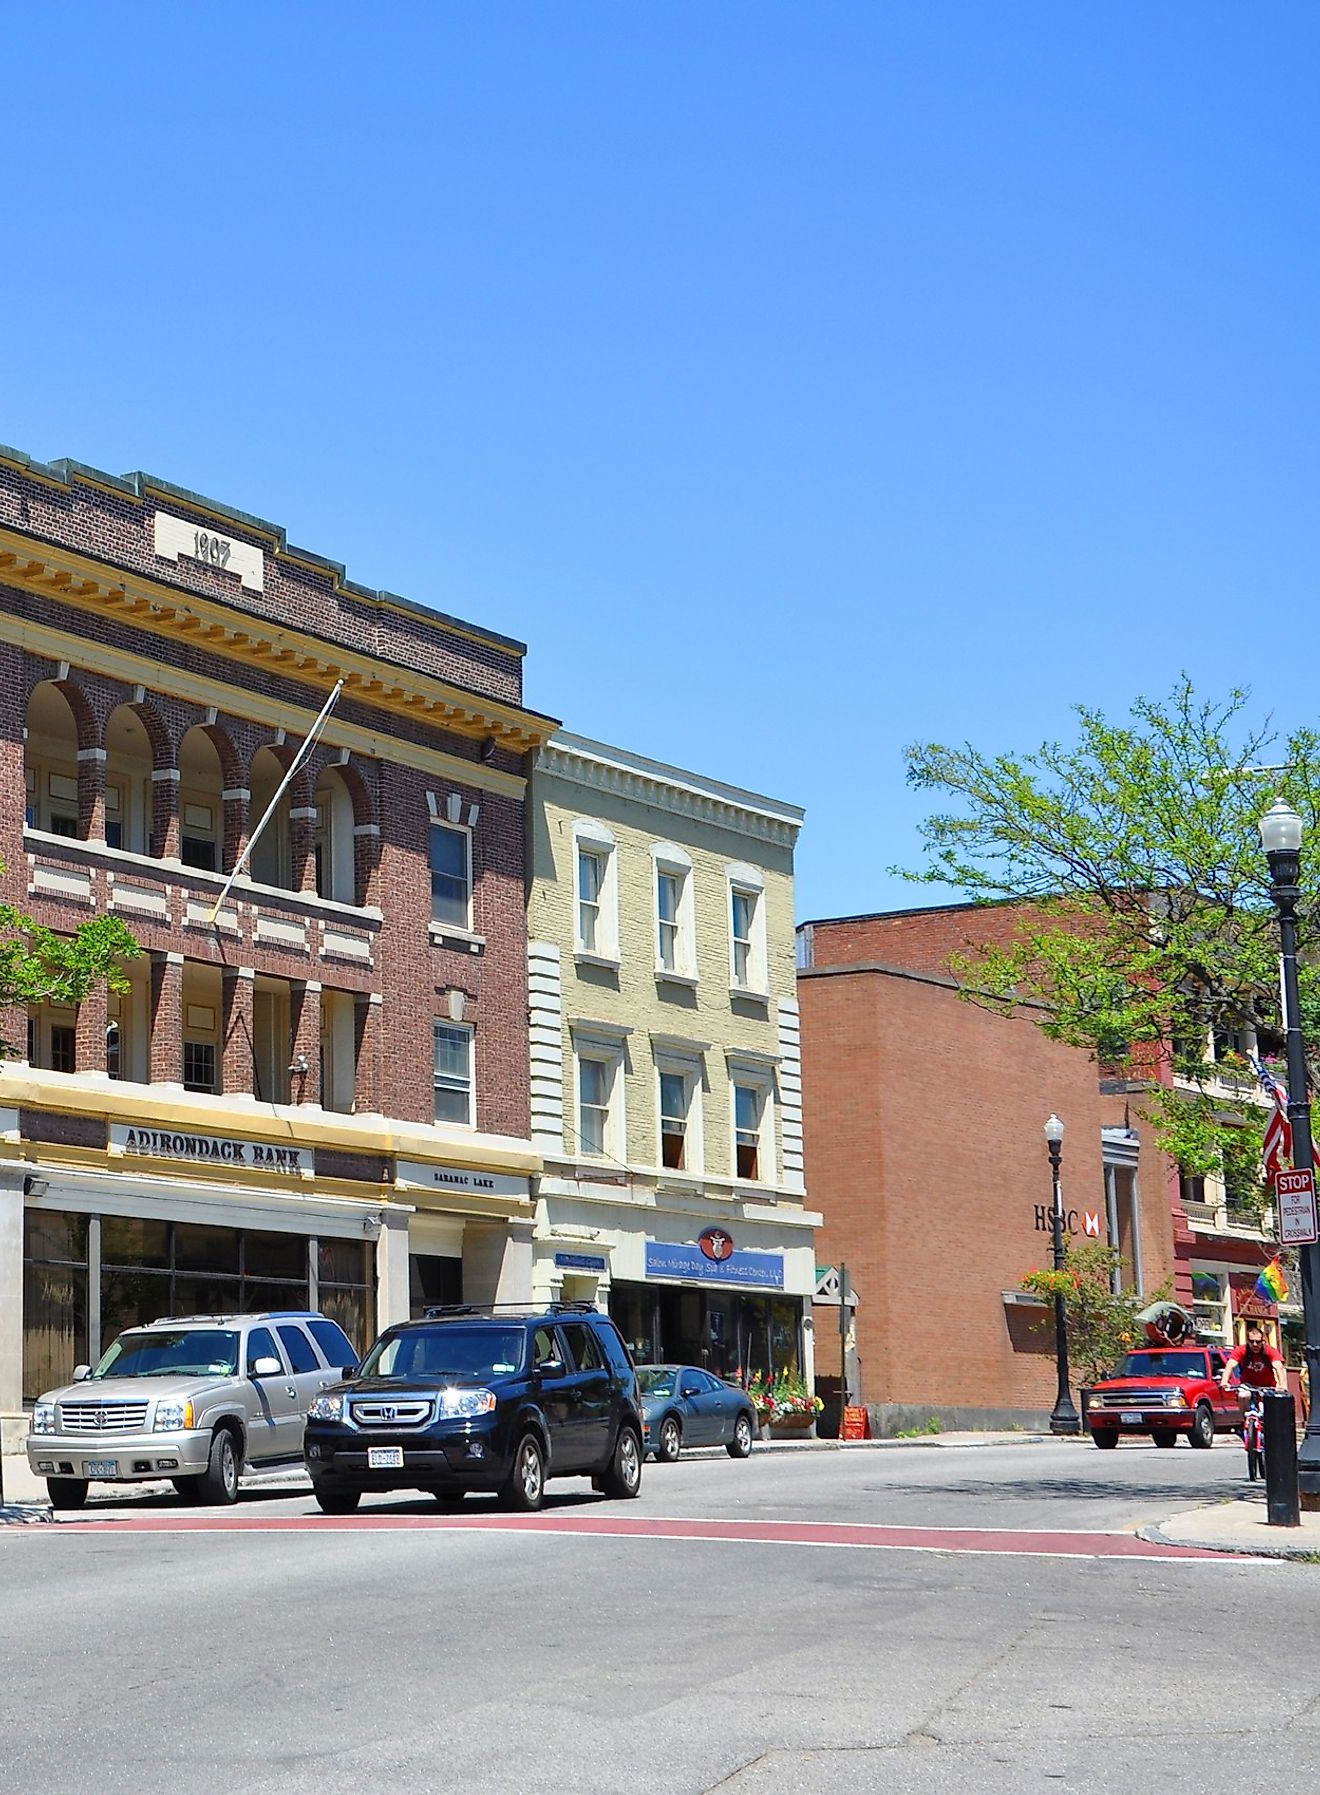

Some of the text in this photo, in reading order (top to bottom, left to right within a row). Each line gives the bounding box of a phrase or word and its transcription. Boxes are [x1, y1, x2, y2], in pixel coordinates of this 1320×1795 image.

[194, 531, 231, 568] 1907
[126, 1129, 301, 1167] ADIRONDACK BANK
[434, 1172, 495, 1188] SARANAC LAKE
[1280, 1175, 1309, 1191] STOP
[1291, 1195, 1300, 1205] FOR
[647, 1257, 667, 1268] Salon
